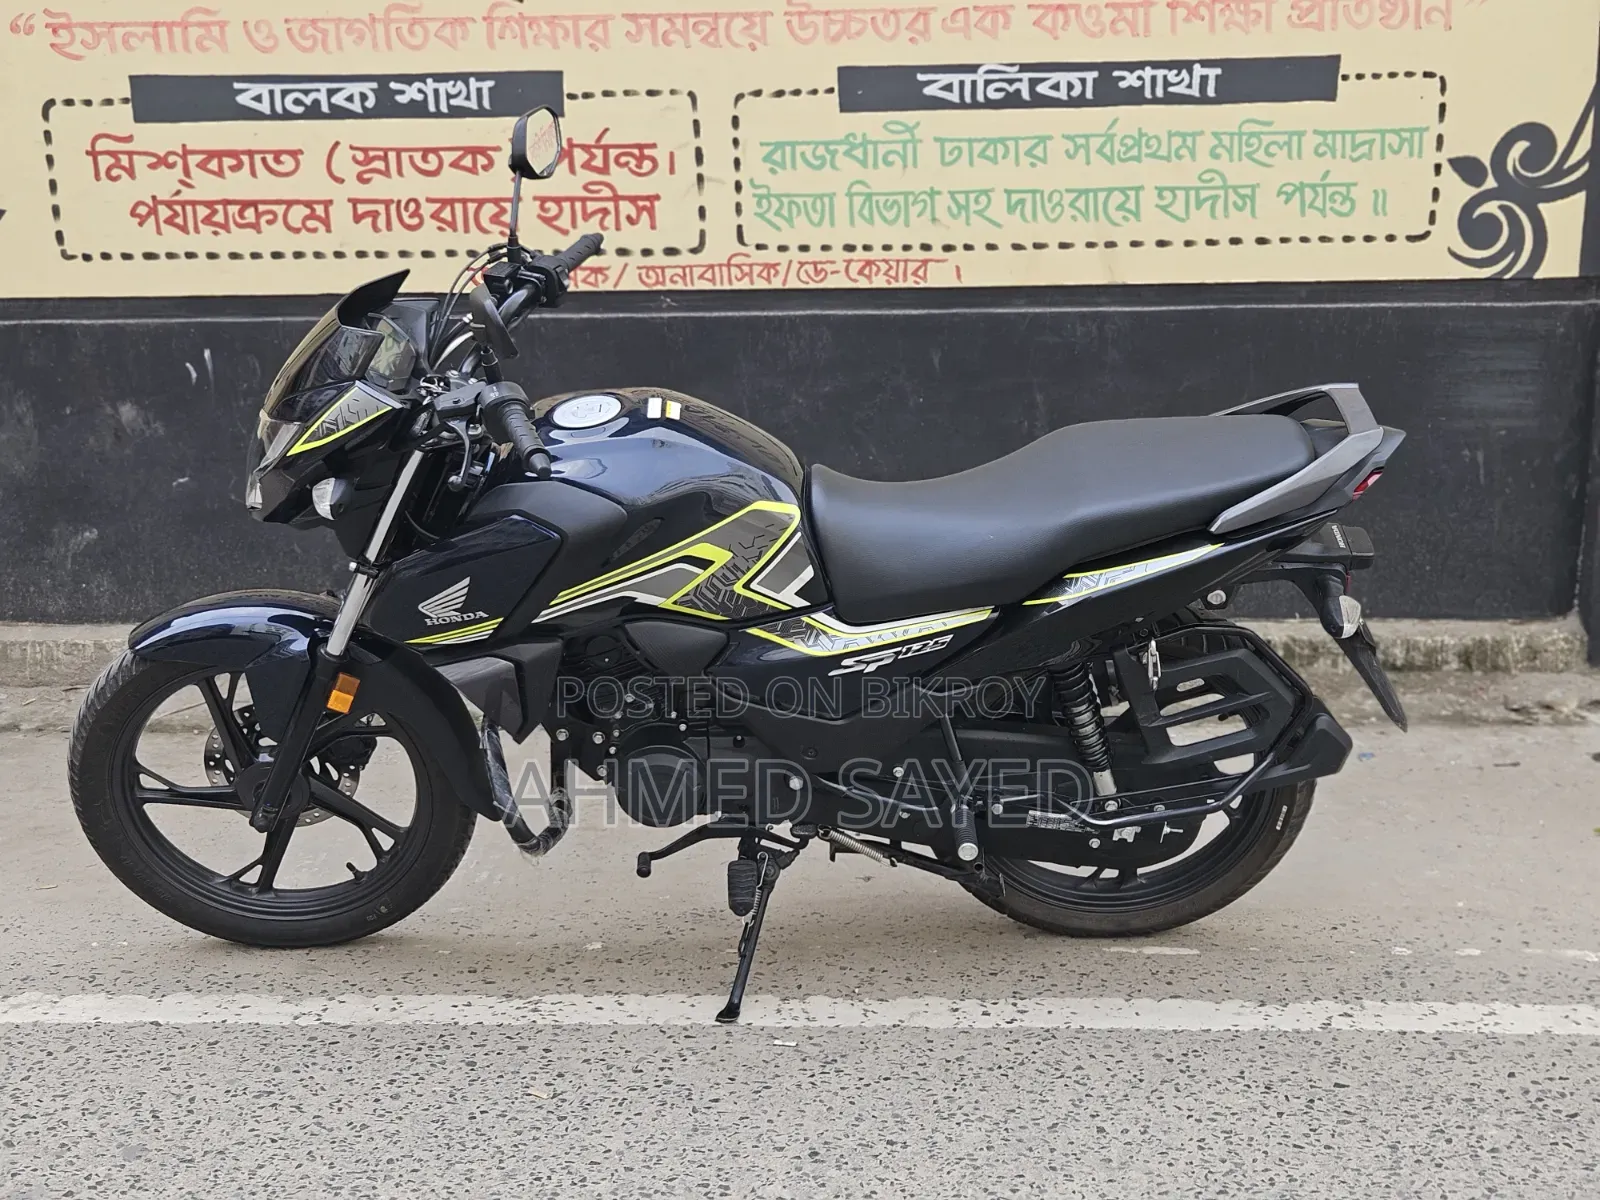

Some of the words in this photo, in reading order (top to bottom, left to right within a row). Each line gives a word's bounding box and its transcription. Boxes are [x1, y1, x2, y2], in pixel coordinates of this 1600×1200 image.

[243, 19, 279, 54] ও
[284, 1, 476, 54] জাগতিক
[482, 1, 616, 52] শিক্ষার
[622, 8, 774, 51] সমন্বয়ে
[941, 5, 1016, 41] এক
[233, 81, 379, 115] বালক
[389, 77, 496, 112] শাখা
[917, 63, 1099, 104] বালিকা
[1112, 63, 1222, 99] শাখা
[760, 120, 924, 175] রাজধানী
[933, 135, 1054, 168] ঢাকার
[1062, 117, 1205, 165] সর্বপ্রথম
[1208, 119, 1306, 167] মহিলা
[1313, 126, 1430, 162] মাদ্রাসা
[533, 181, 661, 236] হাদীস
[749, 178, 837, 233] ইফতা
[845, 179, 942, 229] বিভাগ
[946, 187, 1004, 229] সহ
[1004, 184, 1145, 227] দাওরায়ে
[1154, 168, 1261, 224] হাদীস
[1276, 170, 1359, 218] পর্যন্ত
[424, 610, 490, 626] HONDA
